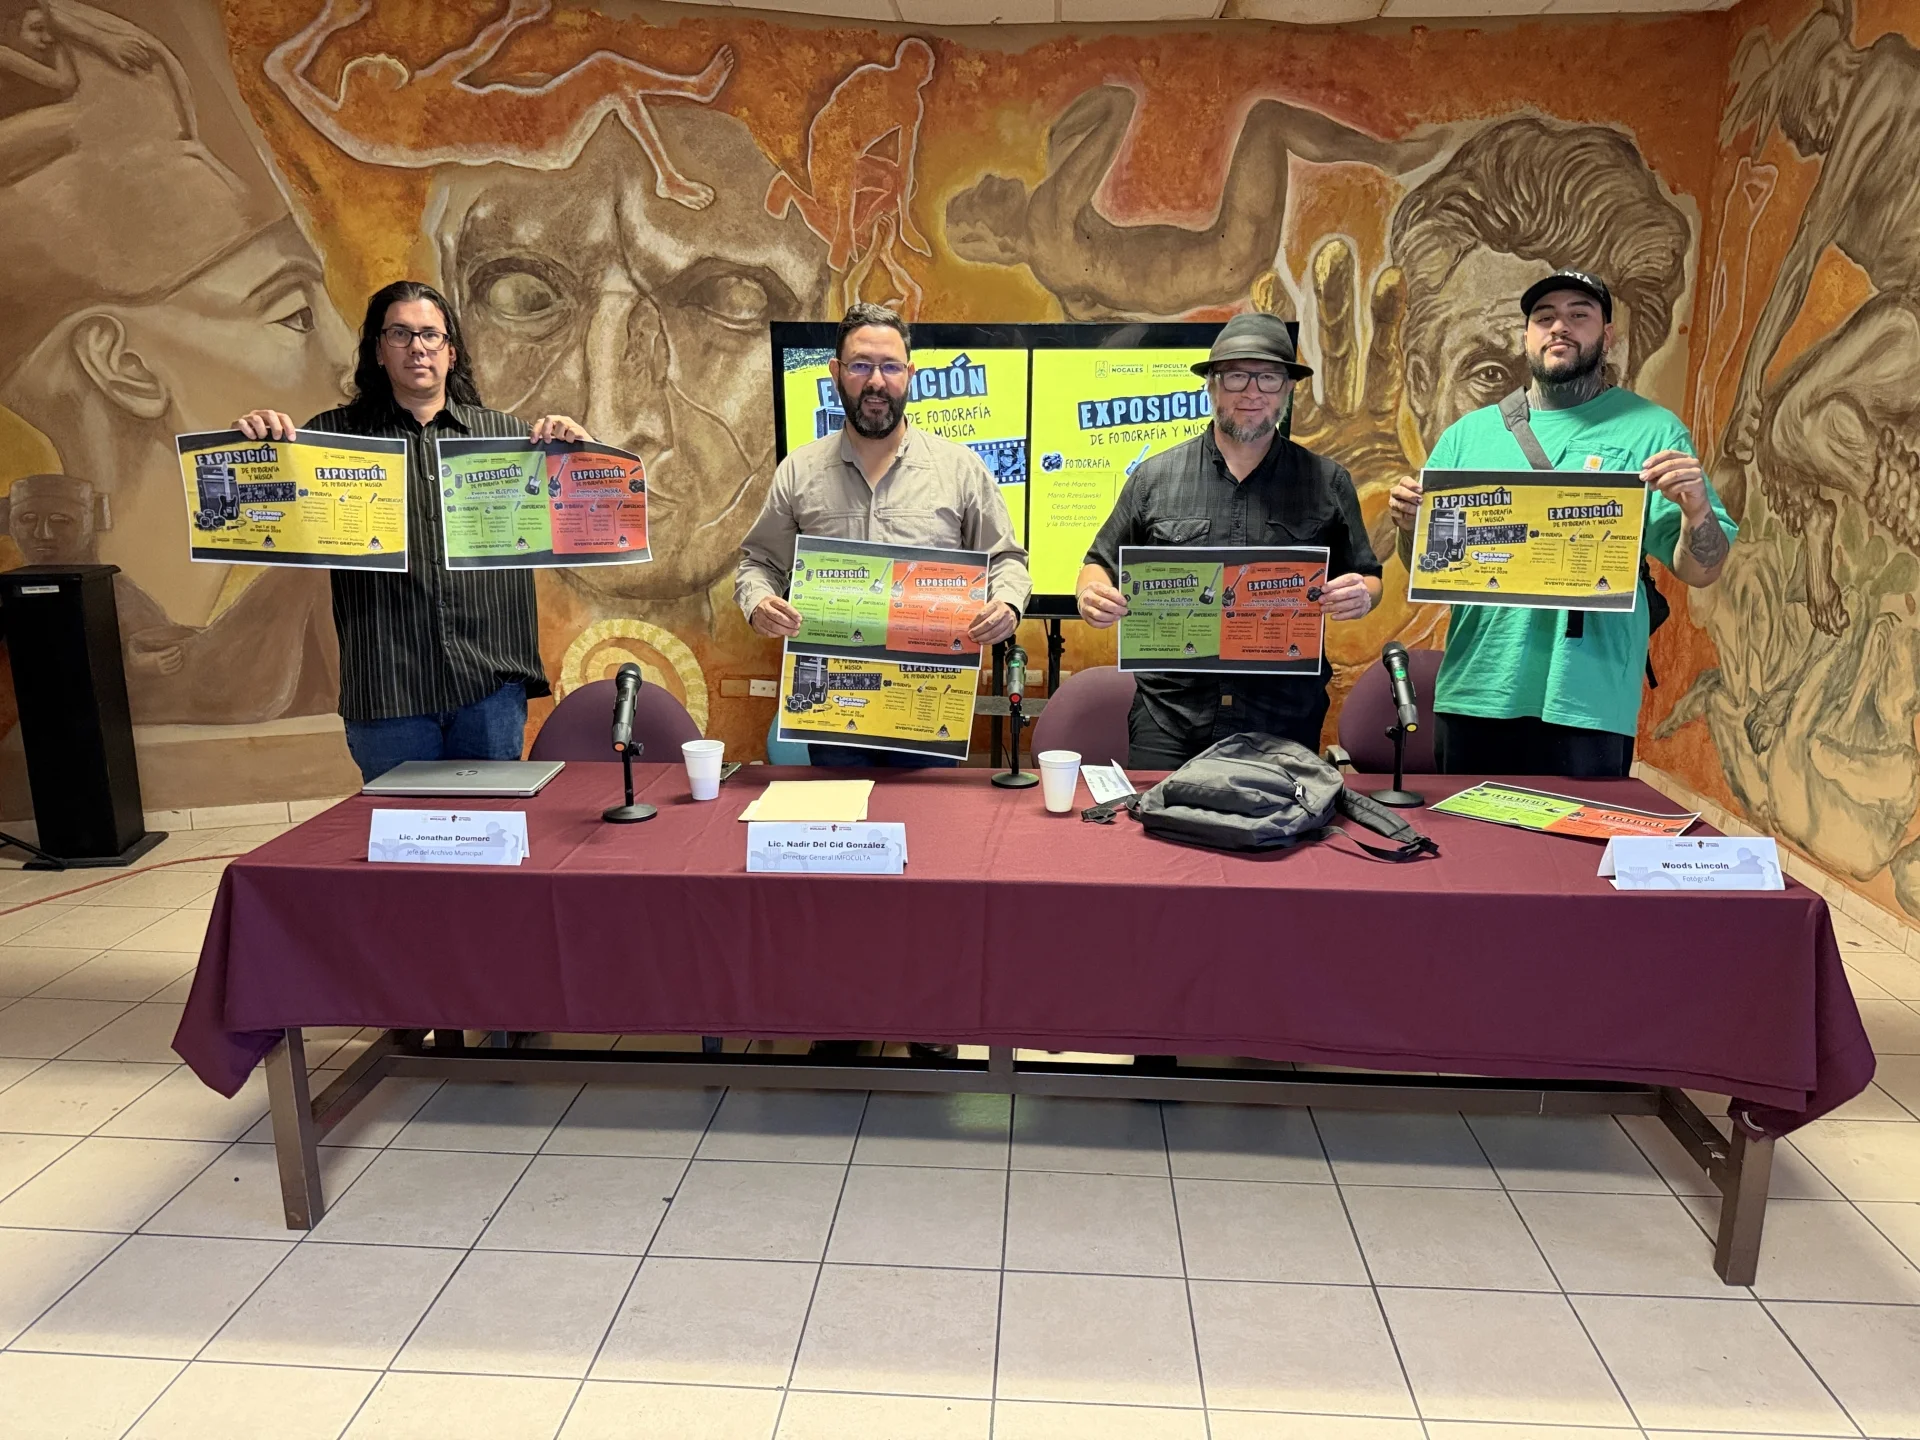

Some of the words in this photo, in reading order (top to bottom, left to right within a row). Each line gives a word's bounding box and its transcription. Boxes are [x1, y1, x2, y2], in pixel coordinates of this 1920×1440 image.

[1080, 384, 1211, 428] EXPOSICIÓ
[907, 412, 922, 424] DE
[927, 406, 991, 424] FOTOGRAFÍA
[934, 423, 976, 438] MÚSICA
[1090, 434, 1104, 446] DE
[1109, 425, 1167, 444] FOTOGRAFÍA
[1172, 426, 1178, 438] Y
[1184, 422, 1208, 437] MÚS
[196, 445, 277, 466] EXPOSICIÓN
[1065, 456, 1111, 469] FOTOGRAFÍA
[241, 467, 249, 475] DE
[316, 466, 386, 480] EXPOSICIÓN
[466, 464, 522, 483] EXPOSICIÓN
[572, 466, 626, 481] EXPOSICIÓN
[1434, 488, 1511, 508] EXPOSICIÓN
[1481, 508, 1513, 516] FOTOGRAFÍA
[1549, 501, 1622, 520] EXPOSICIÓN
[817, 567, 869, 578] EXPOSICIÓN
[916, 576, 967, 587] EXPOSICIÓN
[1144, 574, 1198, 590] EXPOSICIÓN
[1248, 574, 1305, 591] EXPOSICIÓN
[768, 840, 784, 848] Lic.
[846, 841, 885, 849] González
[1662, 862, 1693, 870] Woods
[1695, 862, 1730, 870] Lincoln
[1682, 875, 1715, 884] Fotógrafo
